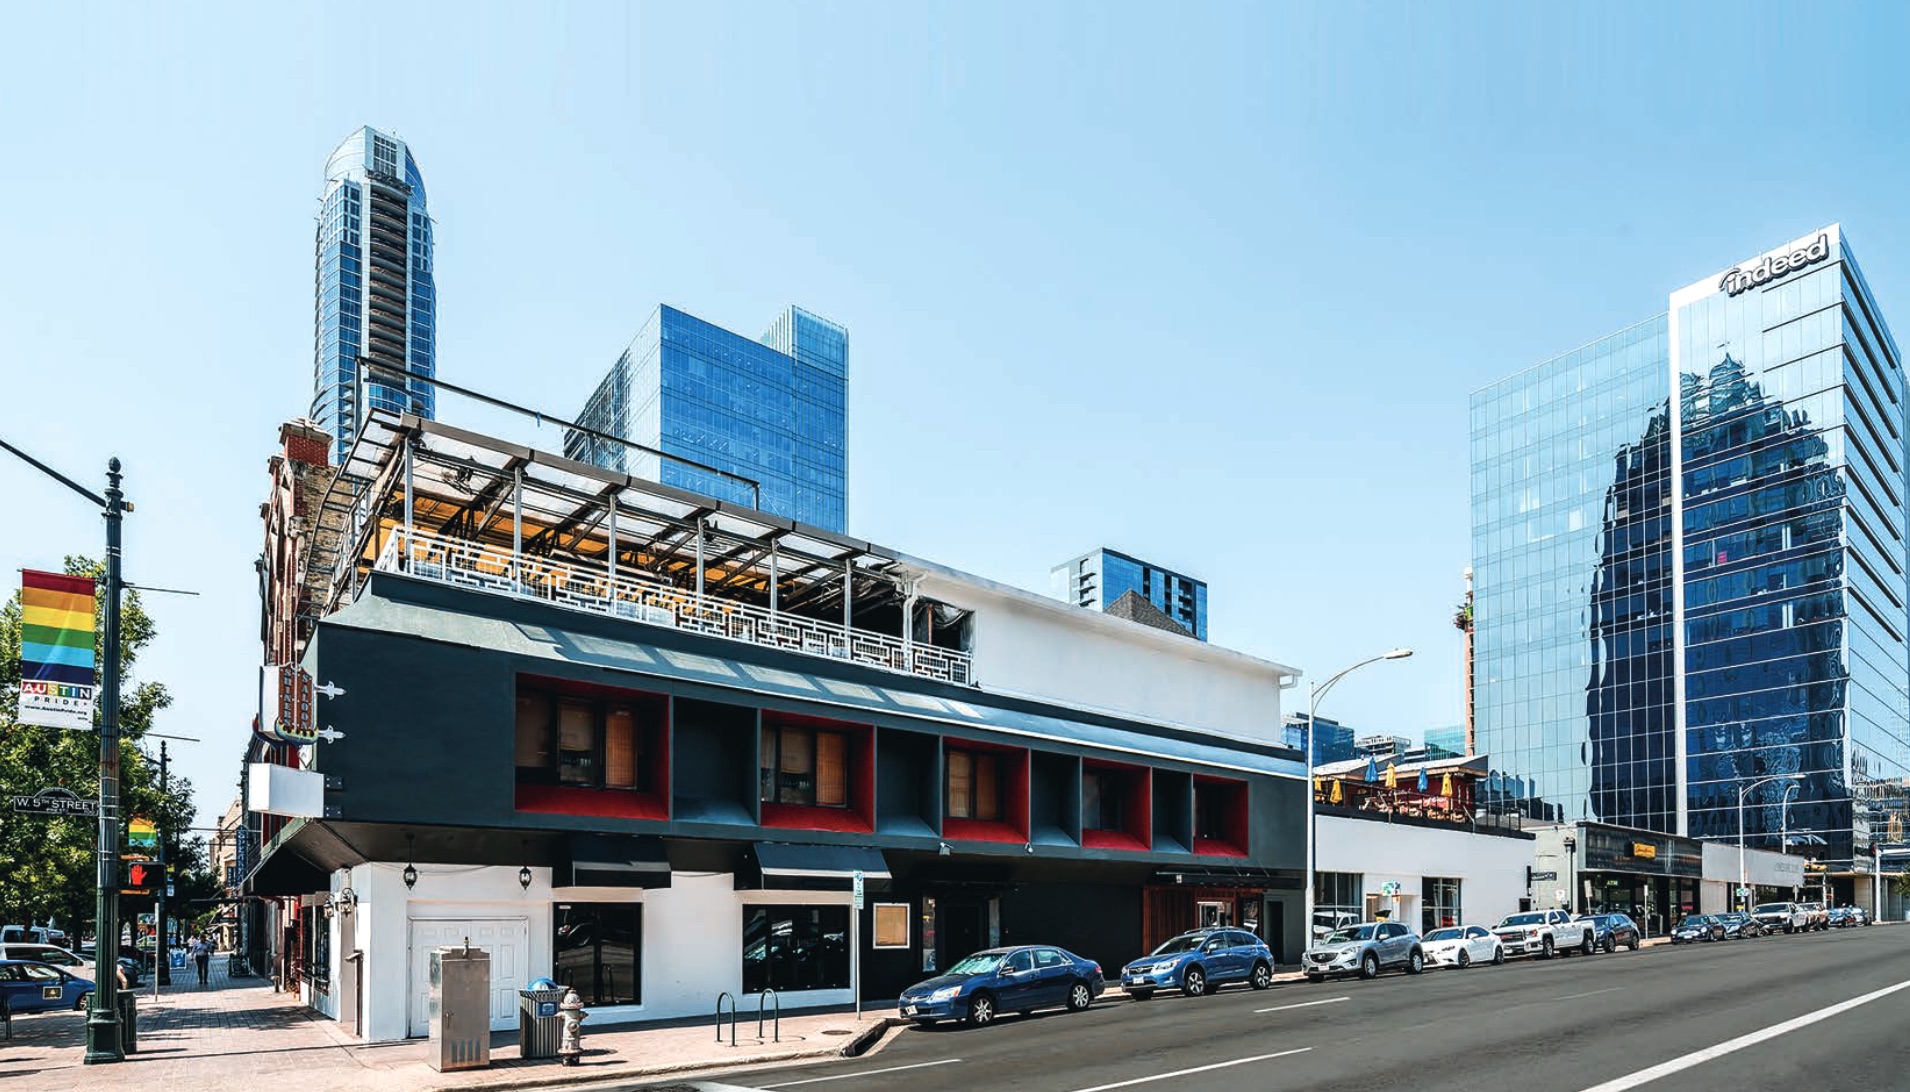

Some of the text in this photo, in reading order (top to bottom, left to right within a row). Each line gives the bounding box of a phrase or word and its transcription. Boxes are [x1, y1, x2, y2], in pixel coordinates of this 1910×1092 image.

[1719, 233, 1829, 297] indeed
[23, 682, 91, 699] AUSTIN
[34, 695, 79, 707] PRIDE
[301, 674, 309, 730] SALOON
[16, 797, 30, 807] W.
[51, 800, 95, 810] STREET
